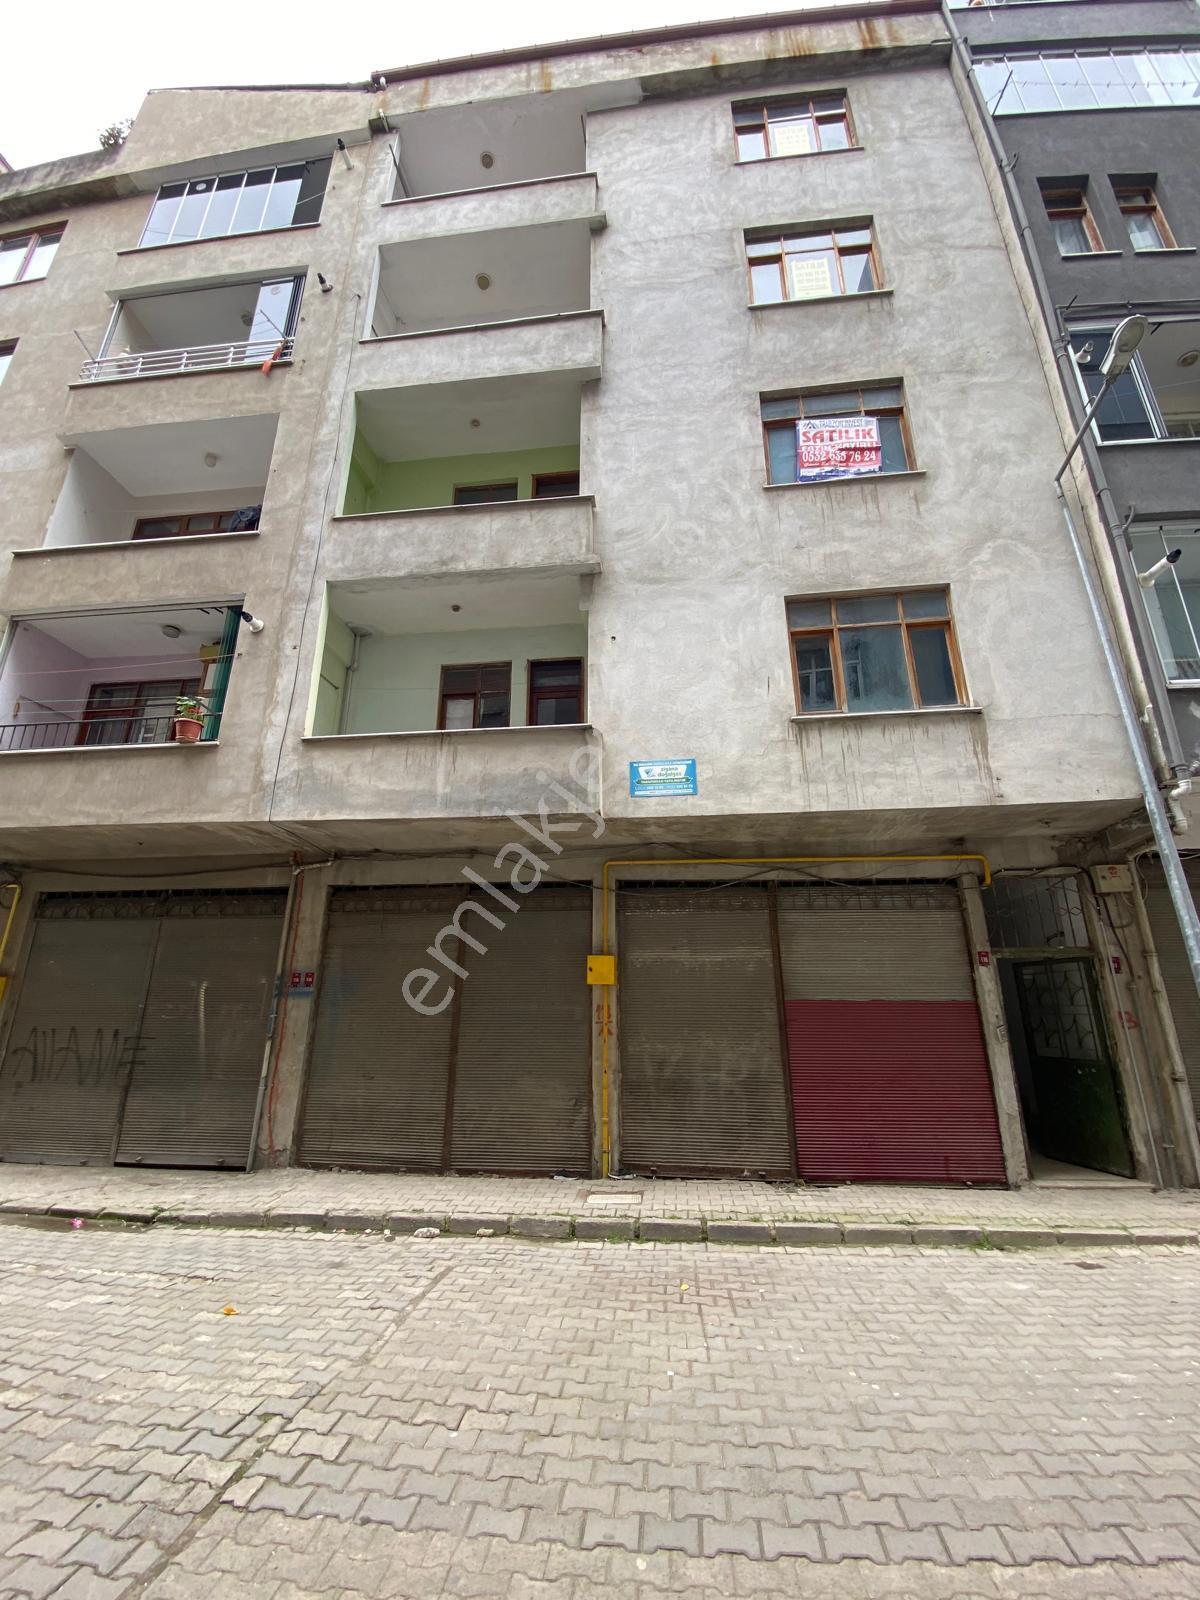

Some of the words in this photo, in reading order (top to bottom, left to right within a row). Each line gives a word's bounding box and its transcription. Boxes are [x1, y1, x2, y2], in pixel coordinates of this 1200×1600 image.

[802, 429, 874, 442] SATILIK
[802, 450, 826, 462] 0532
[850, 450, 861, 462] 76
[864, 450, 876, 461] 24
